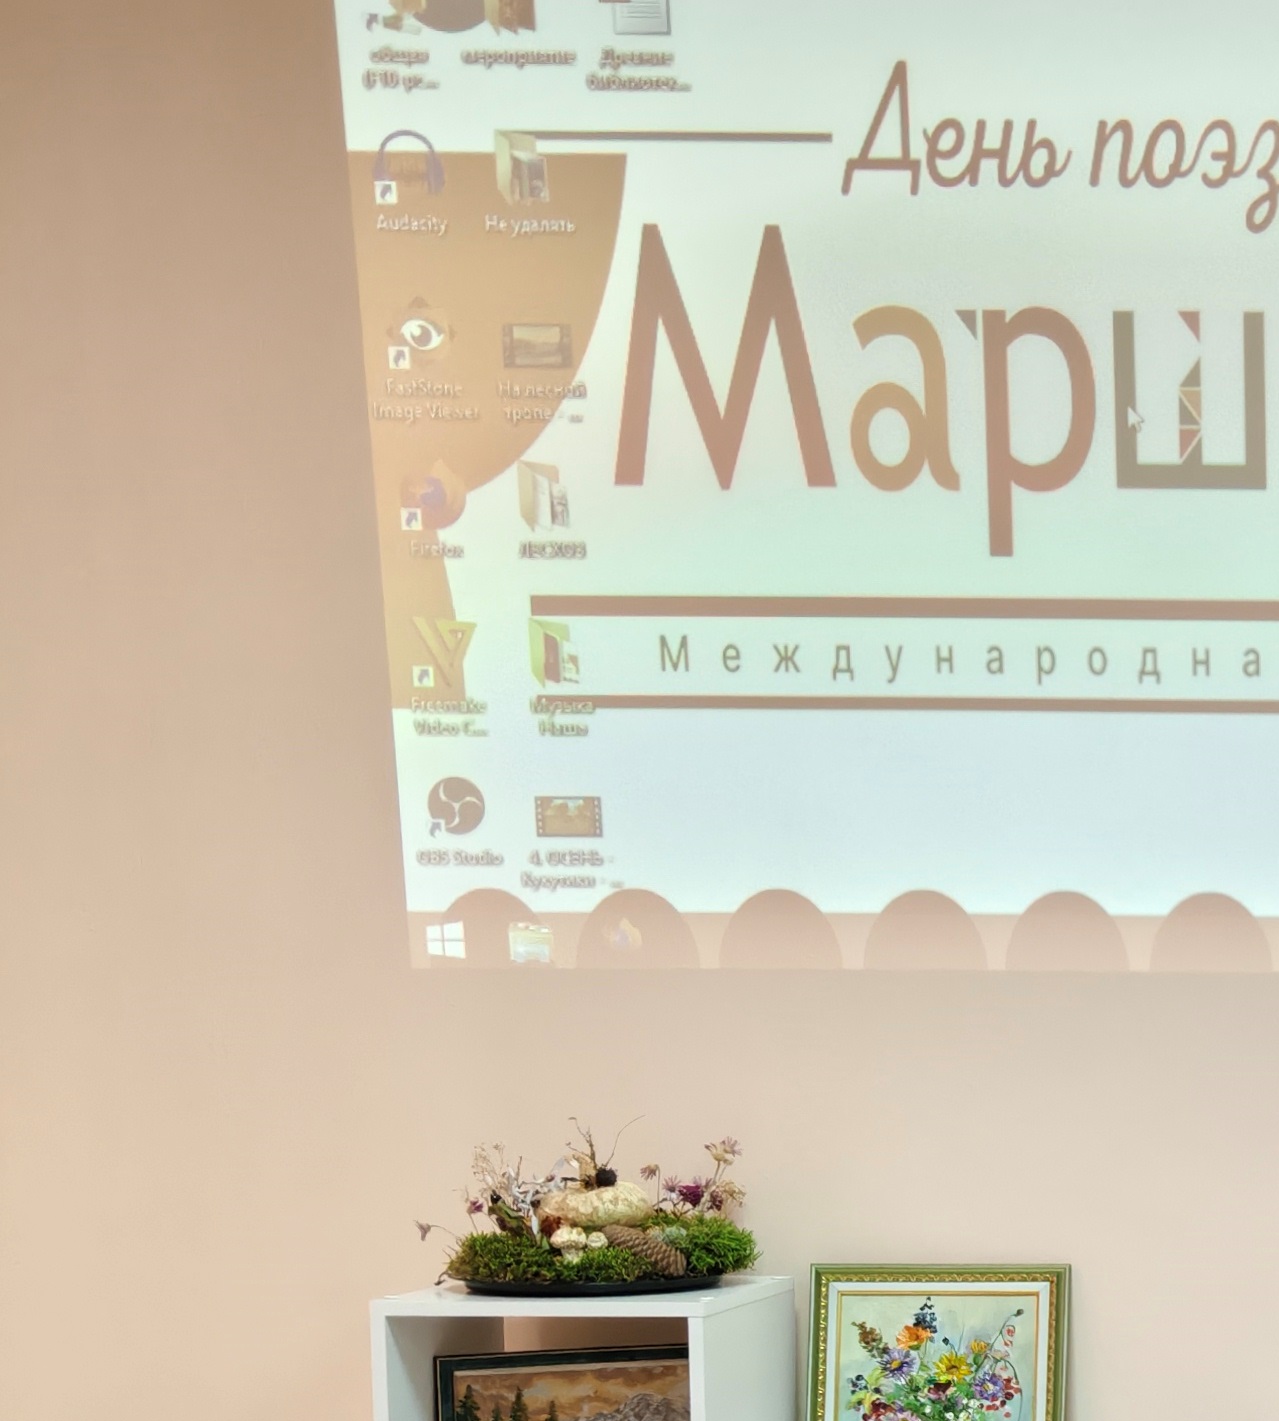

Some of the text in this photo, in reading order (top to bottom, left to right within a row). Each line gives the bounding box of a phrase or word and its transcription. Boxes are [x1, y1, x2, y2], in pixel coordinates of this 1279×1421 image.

[841, 60, 1071, 196] День
[376, 213, 448, 236] Audacity
[484, 214, 576, 237] Не удалять
[373, 402, 423, 424] Image
